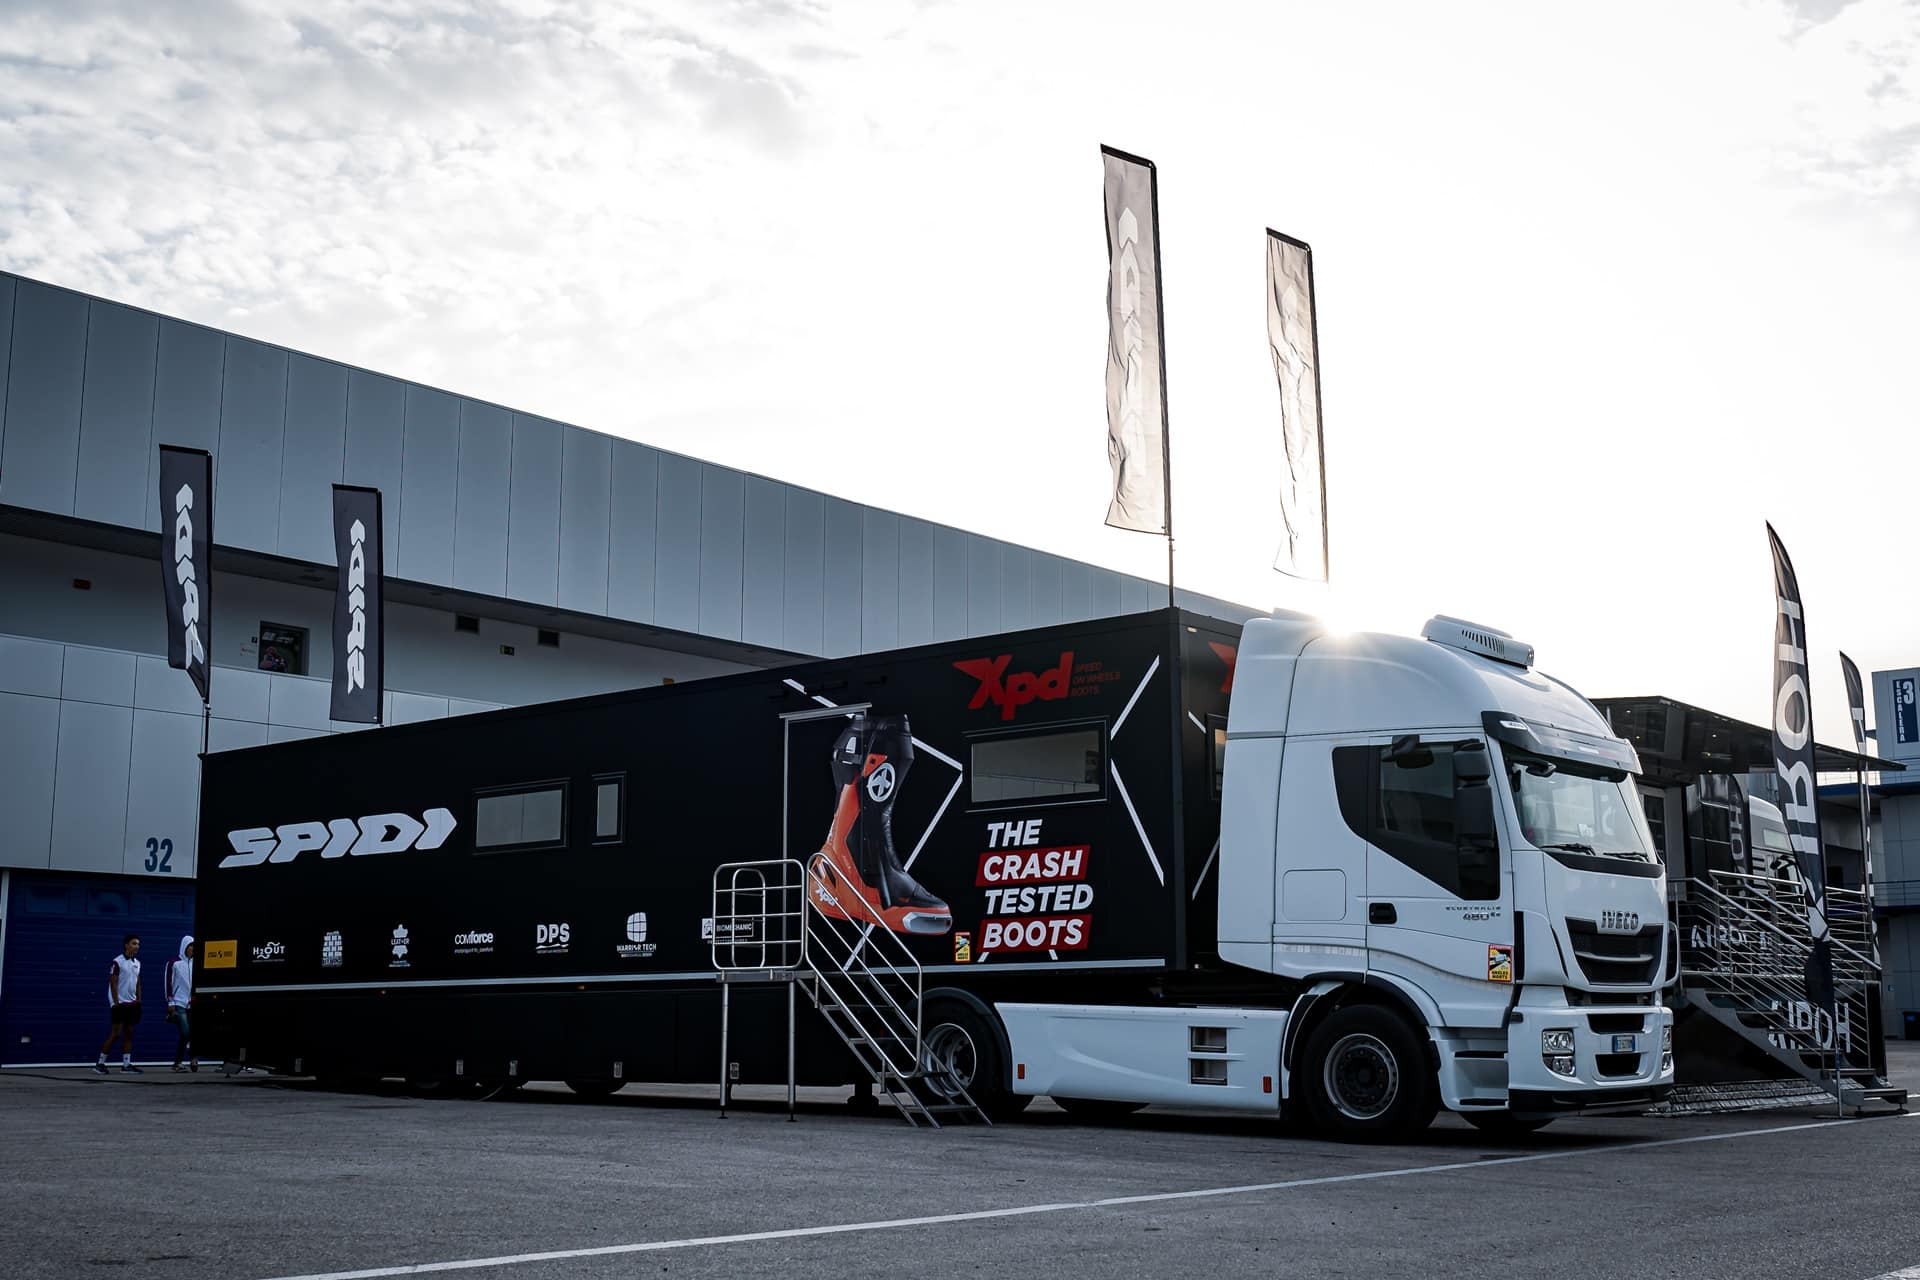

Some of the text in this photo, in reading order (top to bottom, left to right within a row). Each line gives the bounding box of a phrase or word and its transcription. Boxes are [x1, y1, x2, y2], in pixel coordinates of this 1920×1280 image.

[952, 651, 1074, 720] Xpd
[1902, 681, 1914, 704] 3
[218, 807, 457, 868] SPIDI
[987, 819, 1043, 848] THE
[144, 837, 173, 873] 32
[983, 849, 1083, 881] CRASH
[985, 883, 1094, 914] TESTED
[536, 923, 570, 944] DPS
[983, 918, 1084, 948] BOOTS
[1601, 911, 1640, 930] IVECO
